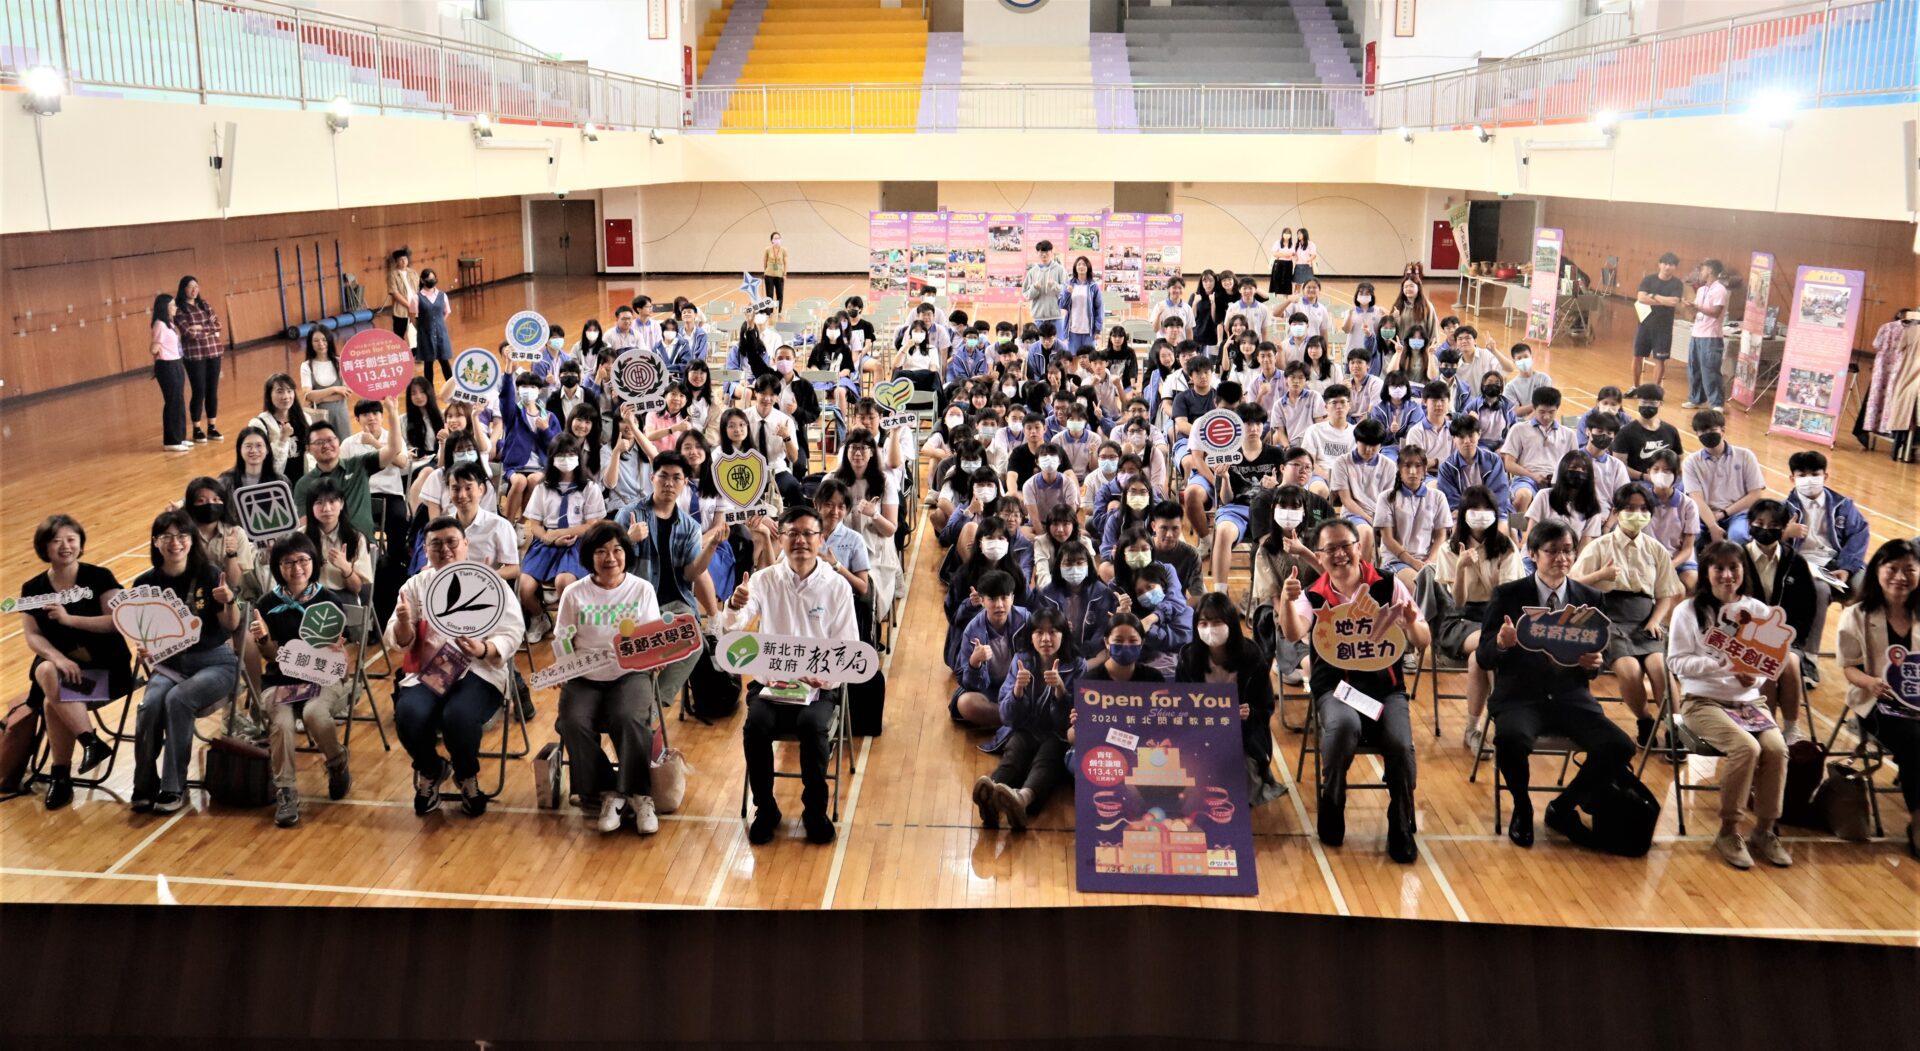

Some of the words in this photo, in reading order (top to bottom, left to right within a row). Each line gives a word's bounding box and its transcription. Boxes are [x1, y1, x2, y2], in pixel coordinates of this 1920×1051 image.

[385, 343, 401, 351] You
[342, 351, 410, 372] 青年創生論壇
[356, 365, 404, 383] 113.4.19
[367, 380, 398, 392] 三民高中
[882, 415, 916, 427] 北大高中
[1644, 440, 1664, 450] NIKE
[1207, 453, 1241, 465] 三民高中
[446, 621, 462, 630] Since
[1335, 617, 1374, 636] 地方
[619, 623, 696, 657] 專題式學習
[763, 641, 807, 658] 新北市
[1336, 640, 1396, 660] 創生力
[1706, 629, 1780, 677] 青年創生
[277, 647, 346, 677] 注腳雙溪
[769, 657, 799, 673] 政府
[806, 641, 868, 675] 教育局
[283, 668, 300, 678] Note
[1902, 663, 1920, 678] 我
[1083, 690, 1143, 710] Open
[1150, 690, 1182, 708] for
[1187, 692, 1231, 709] You
[1091, 714, 1118, 723] 2024
[1087, 768, 1124, 776] 113.4.19
